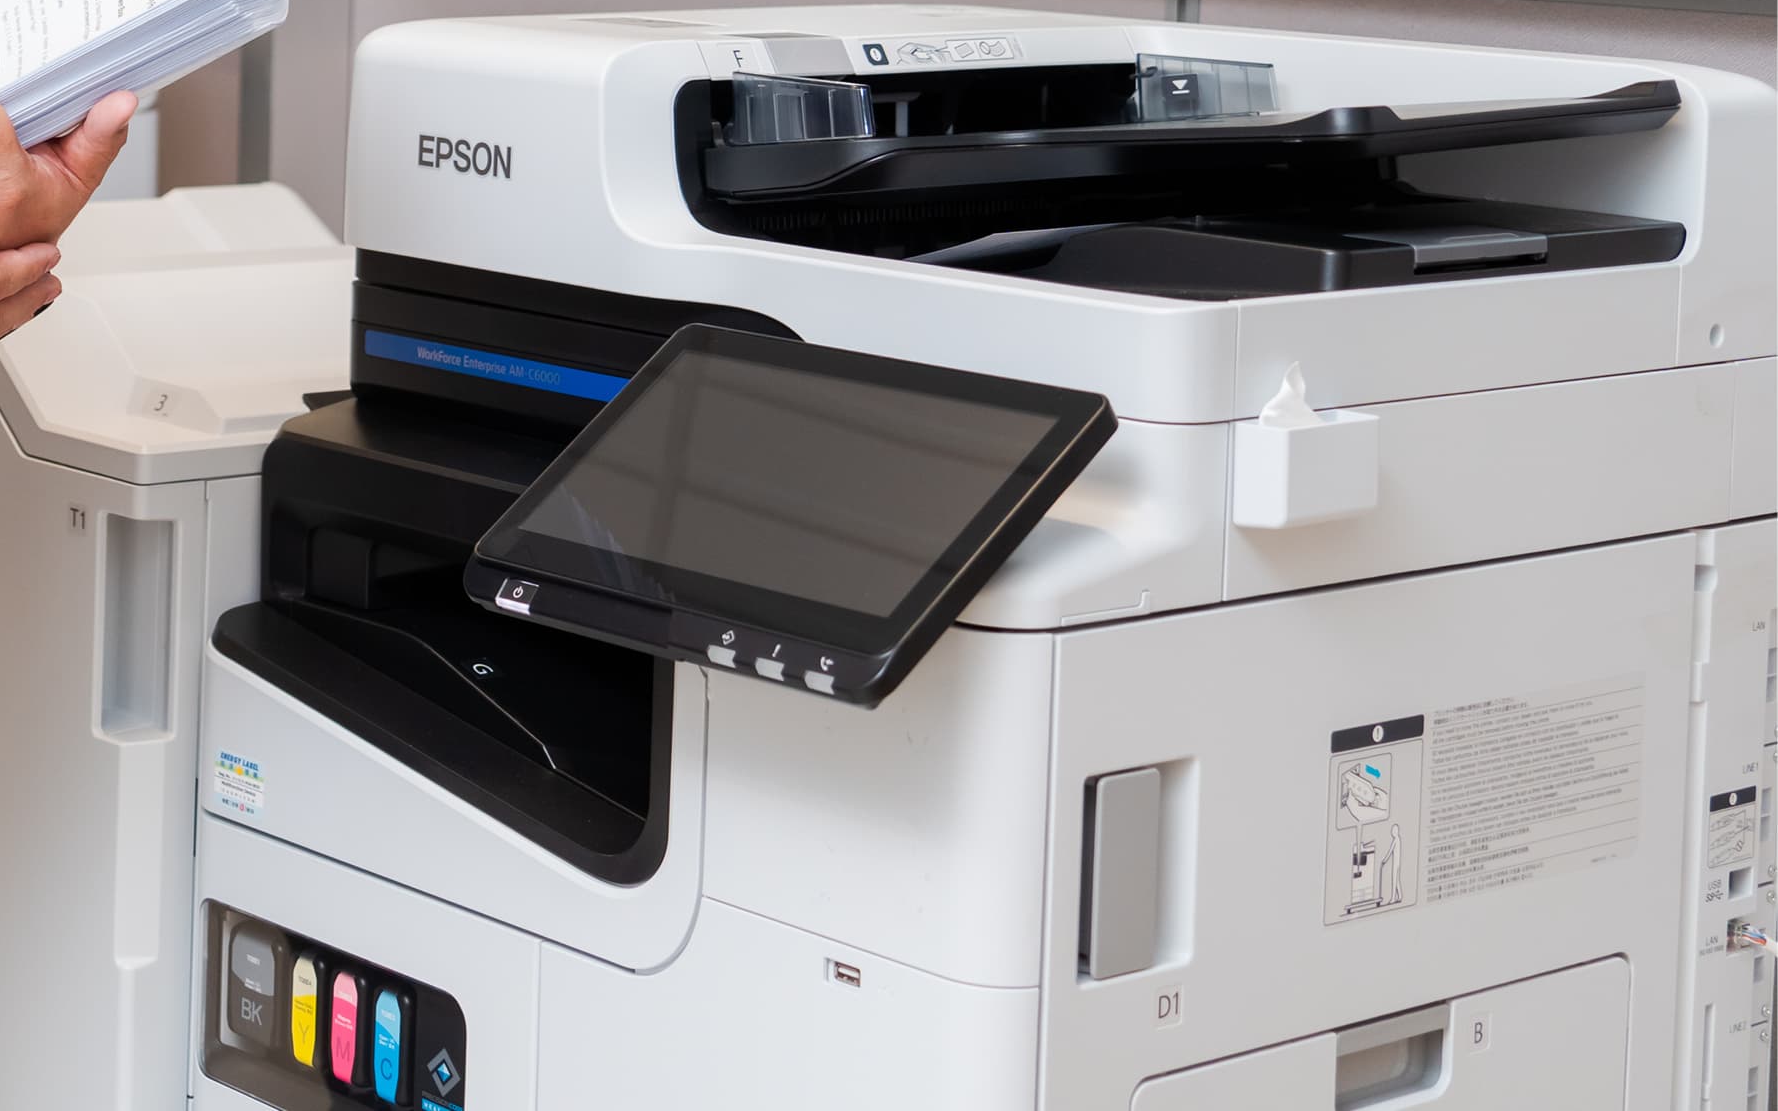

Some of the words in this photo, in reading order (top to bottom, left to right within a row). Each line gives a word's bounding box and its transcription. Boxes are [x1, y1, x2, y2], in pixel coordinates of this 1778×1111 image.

[733, 49, 744, 68] F
[418, 133, 512, 179] EPSON
[417, 346, 462, 366] WorkForce
[463, 355, 507, 375] Enterprise
[509, 363, 561, 385] AM-C6000
[153, 393, 168, 412] 3
[69, 507, 85, 530] T1
[220, 752, 241, 764] ENERGY
[242, 759, 258, 771] LABEL
[241, 997, 263, 1026] BK
[1157, 992, 1179, 1019] D1
[297, 1022, 309, 1044] Y
[1474, 1022, 1483, 1044] B
[335, 1040, 351, 1062] M
[380, 1058, 393, 1081] C
